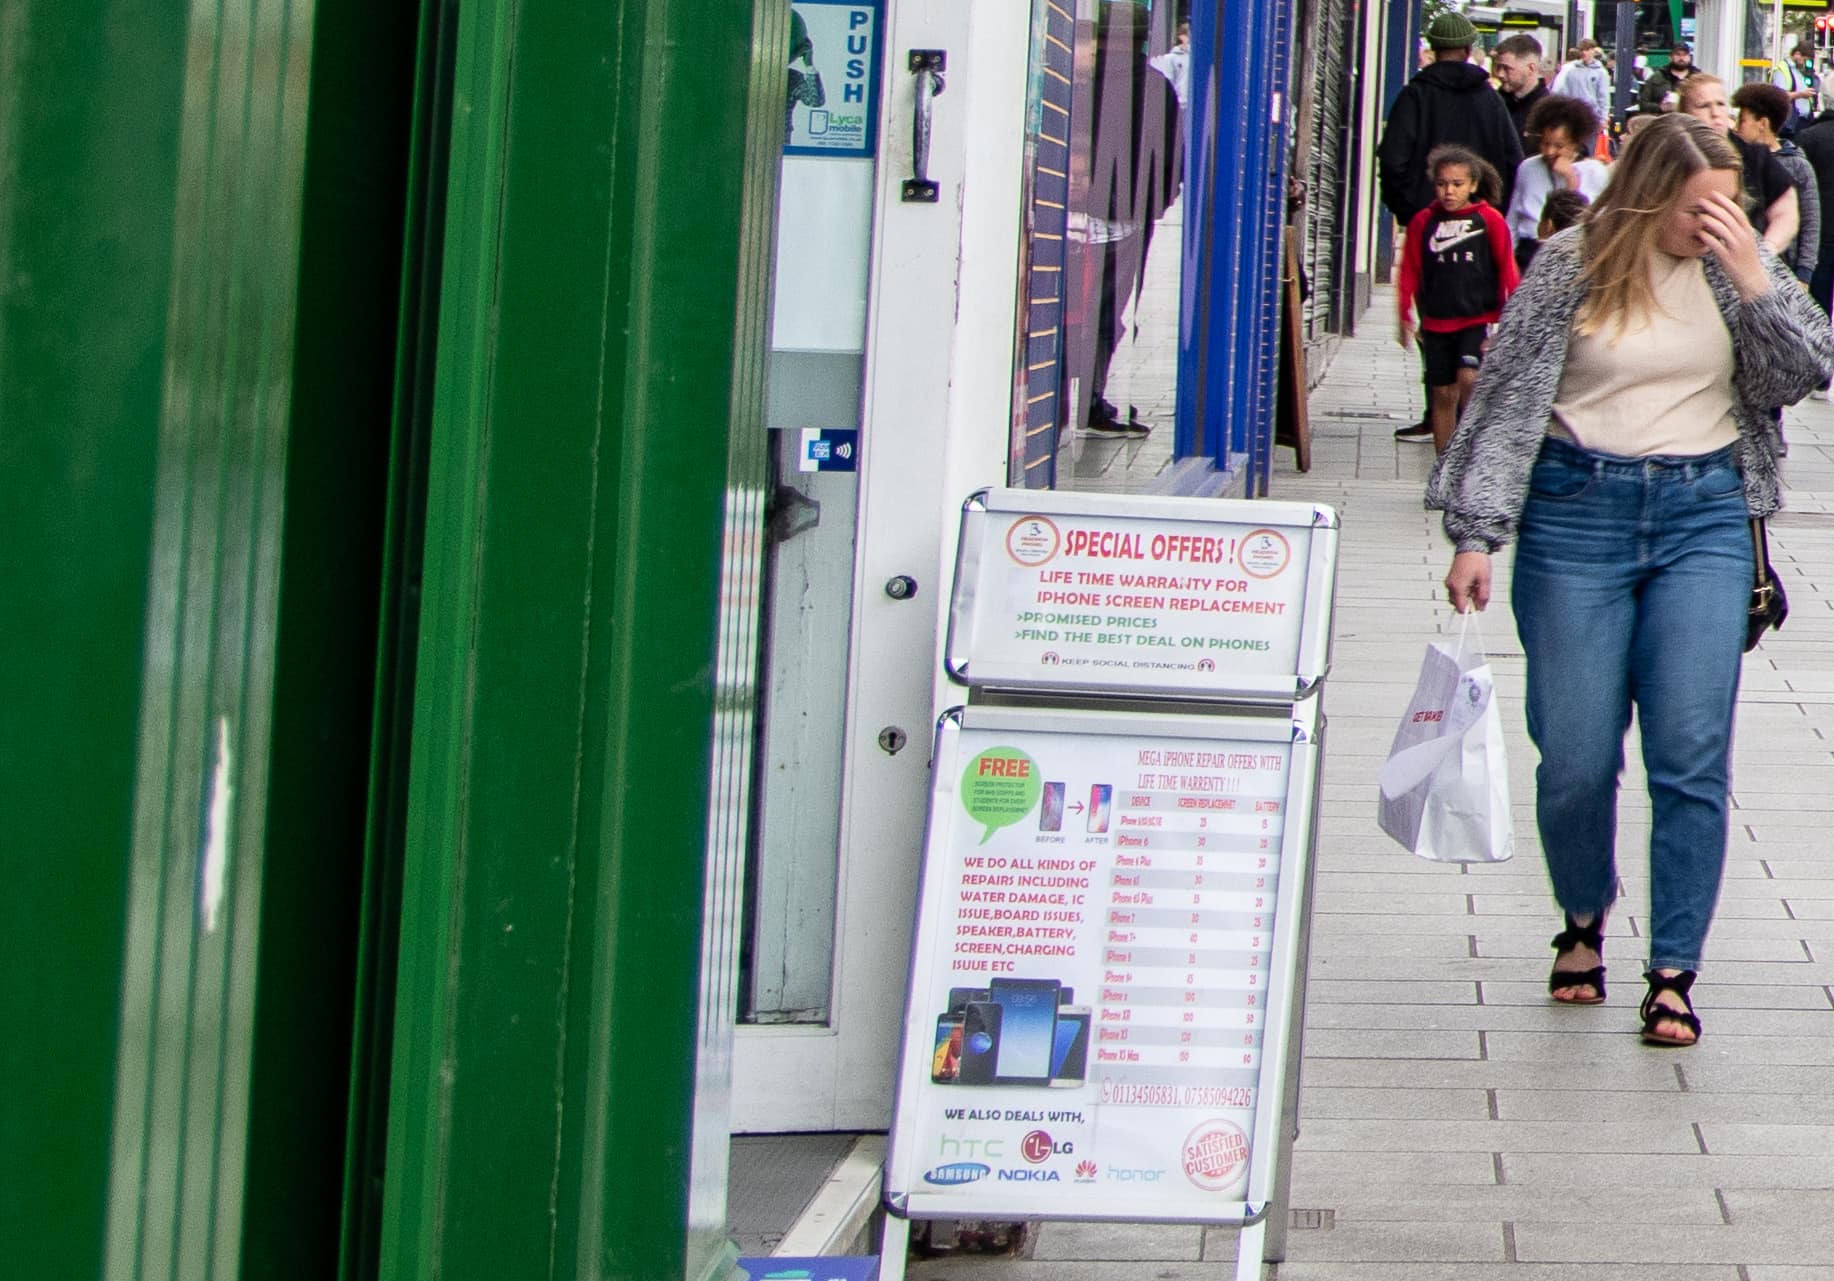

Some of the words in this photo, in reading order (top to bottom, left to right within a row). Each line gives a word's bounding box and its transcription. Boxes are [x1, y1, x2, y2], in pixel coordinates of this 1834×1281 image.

[843, 11, 869, 104] PUSH
[829, 111, 862, 126] Lyca
[1064, 529, 1145, 561] SPECIAL
[1151, 534, 1225, 565] OFFERS
[1040, 570, 1073, 585] LIFE
[1077, 572, 1114, 587] TIME
[1119, 574, 1213, 592] WARRANTY
[1216, 579, 1248, 593] FOR
[1037, 591, 1101, 607] IPHONE
[1105, 594, 1165, 610] SCREEN
[1169, 597, 1287, 615] REPLACEMENT
[1106, 615, 1158, 629] PRICES
[1063, 630, 1094, 644] THE
[1097, 632, 1130, 646] BEST
[1136, 634, 1176, 648] DEAL
[1181, 636, 1205, 649] ON
[1208, 637, 1271, 652] PHONES
[978, 758, 1031, 778] FREE
[1137, 750, 1162, 767] MEGA
[1196, 751, 1226, 769] REPAIR
[1227, 753, 1257, 770] OFFERS
[1259, 754, 1282, 771] WITH
[1137, 773, 1157, 790] LIFE
[1158, 774, 1178, 791] TIME
[1035, 835, 1065, 844] BEFORE
[1085, 836, 1109, 844] AFTER
[963, 856, 985, 868] WE
[987, 857, 1007, 869] DO
[1010, 858, 1034, 870] ALL
[1037, 859, 1076, 871] KINDS
[1078, 860, 1097, 872] OF
[961, 874, 1015, 887] REPAIRS
[1017, 875, 1090, 889] INCLUDING
[960, 891, 1006, 903] WATER
[1008, 892, 1069, 907] DAMAGE,
[1072, 894, 1085, 905] IC
[1043, 910, 1084, 925] ISSUES,
[991, 960, 1015, 972] ETC
[944, 1108, 966, 1120] WE
[968, 1108, 1001, 1121] ALSO
[1004, 1110, 1044, 1122] DEALS
[1047, 1111, 1086, 1124] WITH,
[1052, 1141, 1074, 1155] LG
[1186, 1133, 1243, 1161] SATISFIED
[1185, 1147, 1248, 1176] CUSTOMER
[998, 1169, 1061, 1182] NOKIA
[1107, 1163, 1165, 1183] honor
